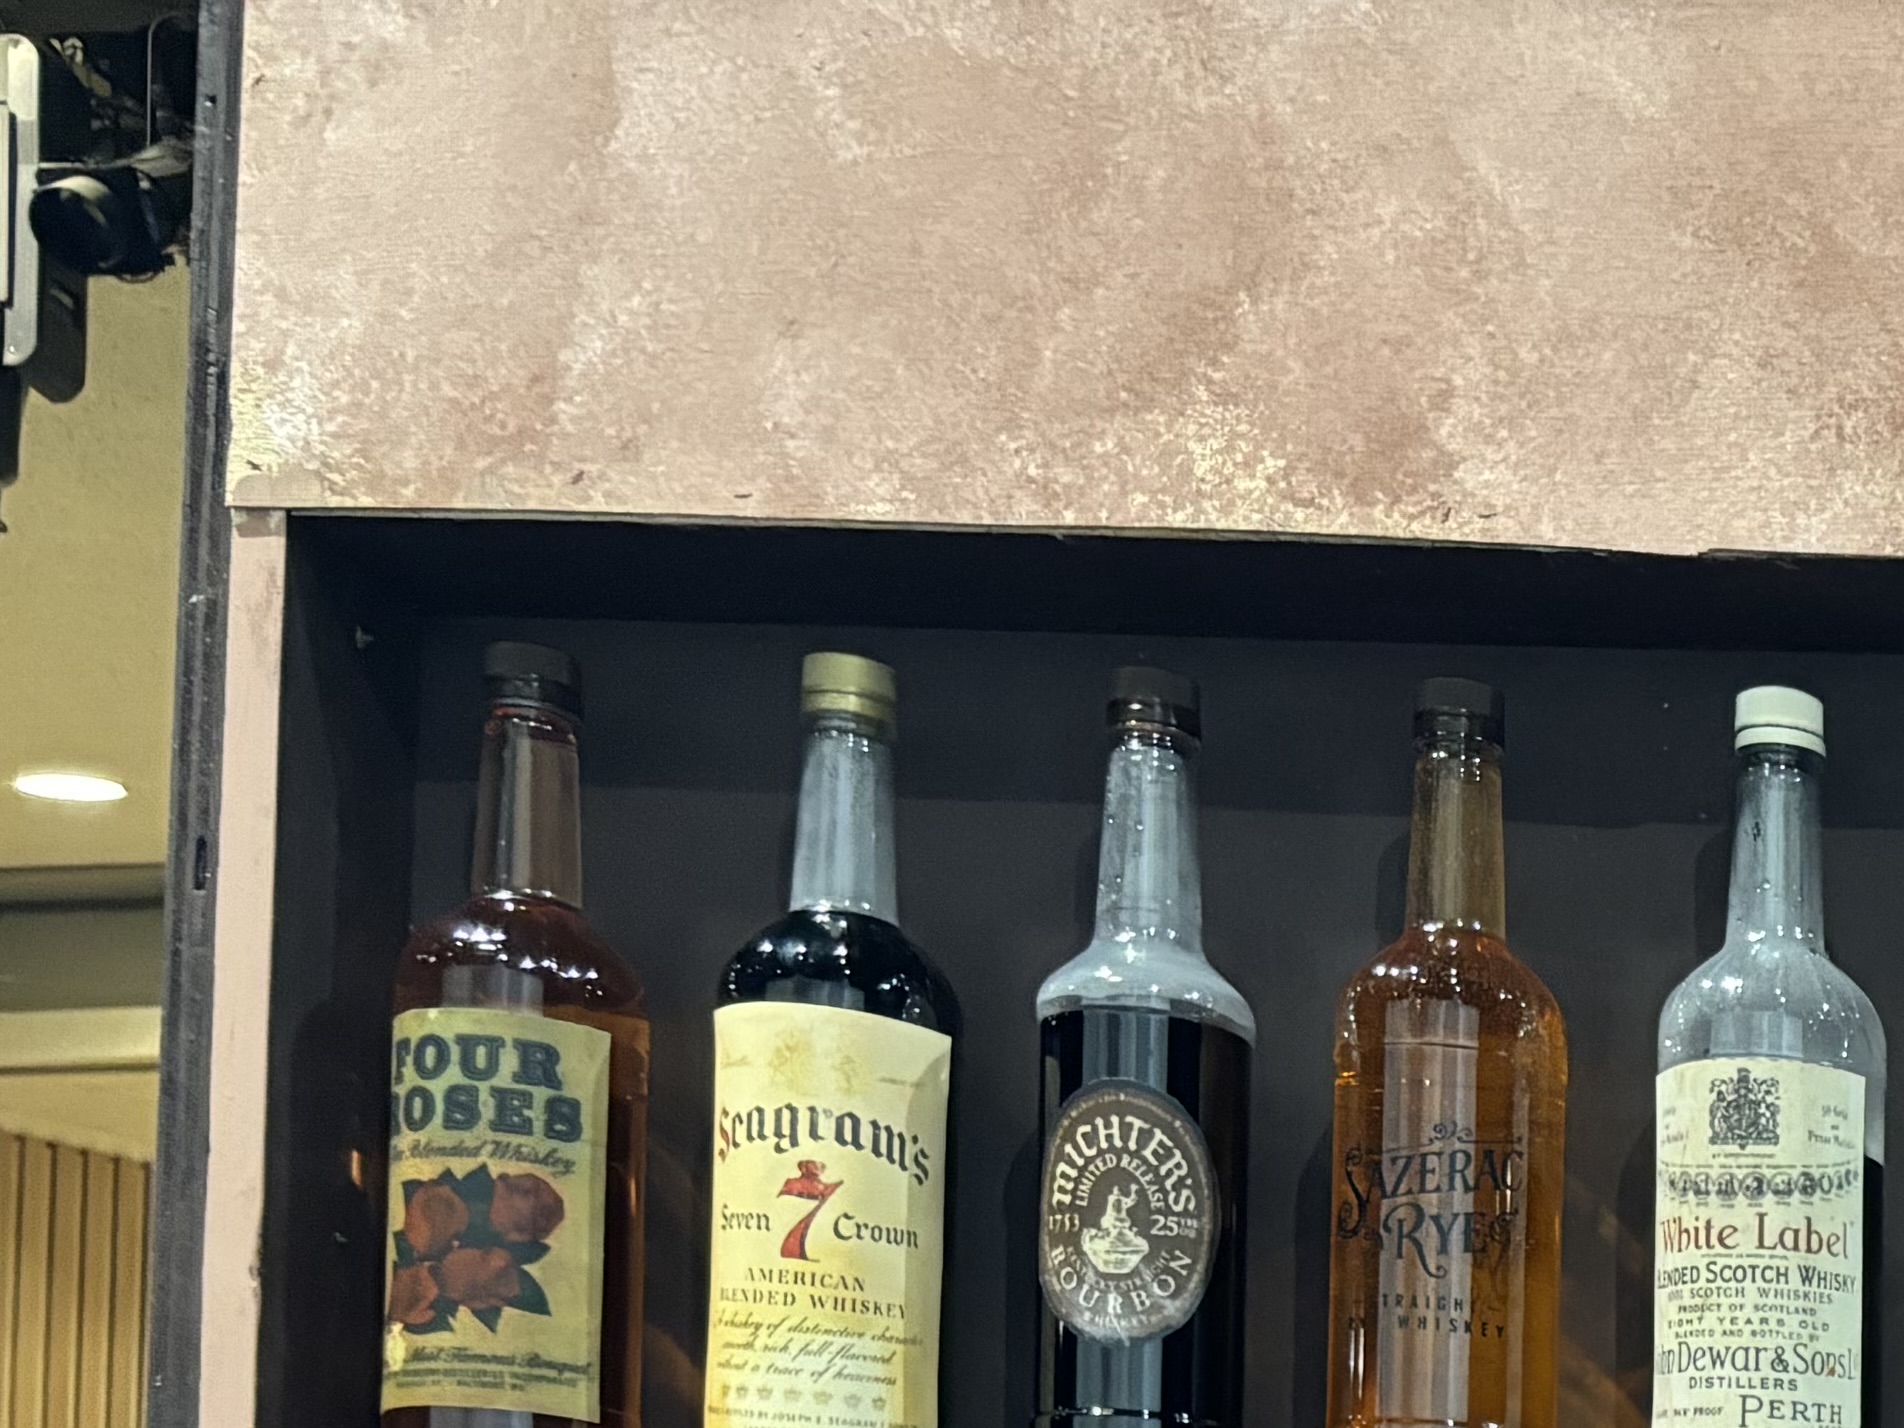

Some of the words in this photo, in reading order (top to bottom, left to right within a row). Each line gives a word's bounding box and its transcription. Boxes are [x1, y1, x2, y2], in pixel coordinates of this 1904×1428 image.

[391, 1084, 583, 1142] OSES
[718, 1101, 930, 1187] Seagram's
[1052, 1114, 1196, 1214] MICHTER'S
[1075, 1153, 1117, 1207] LIMITED
[1120, 1156, 1166, 1210] RELEASE
[1338, 1145, 1525, 1240] SAZERAC
[721, 1203, 771, 1232] Seven
[777, 1160, 844, 1263] 7
[833, 1211, 919, 1249] Crown
[1150, 1215, 1179, 1236] 25
[1660, 1215, 1739, 1256] White
[1756, 1212, 1849, 1260] Label
[744, 1267, 866, 1293] AMERICAN
[1050, 1244, 1193, 1314] BOURBON
[1706, 1261, 1789, 1284] SCOTCH
[809, 1293, 906, 1319] WHISKEY
[1690, 1286, 1745, 1299] SCOTCH
[1757, 1287, 1833, 1304] WHISKIES
[1717, 1317, 1785, 1327] YEARS
[1799, 1320, 1829, 1332] OLD
[1678, 1341, 1768, 1373] Dewar
[1770, 1346, 1789, 1373] &
[1689, 1377, 1798, 1391] DISTILLERS
[1739, 1394, 1841, 1428] PERTH
